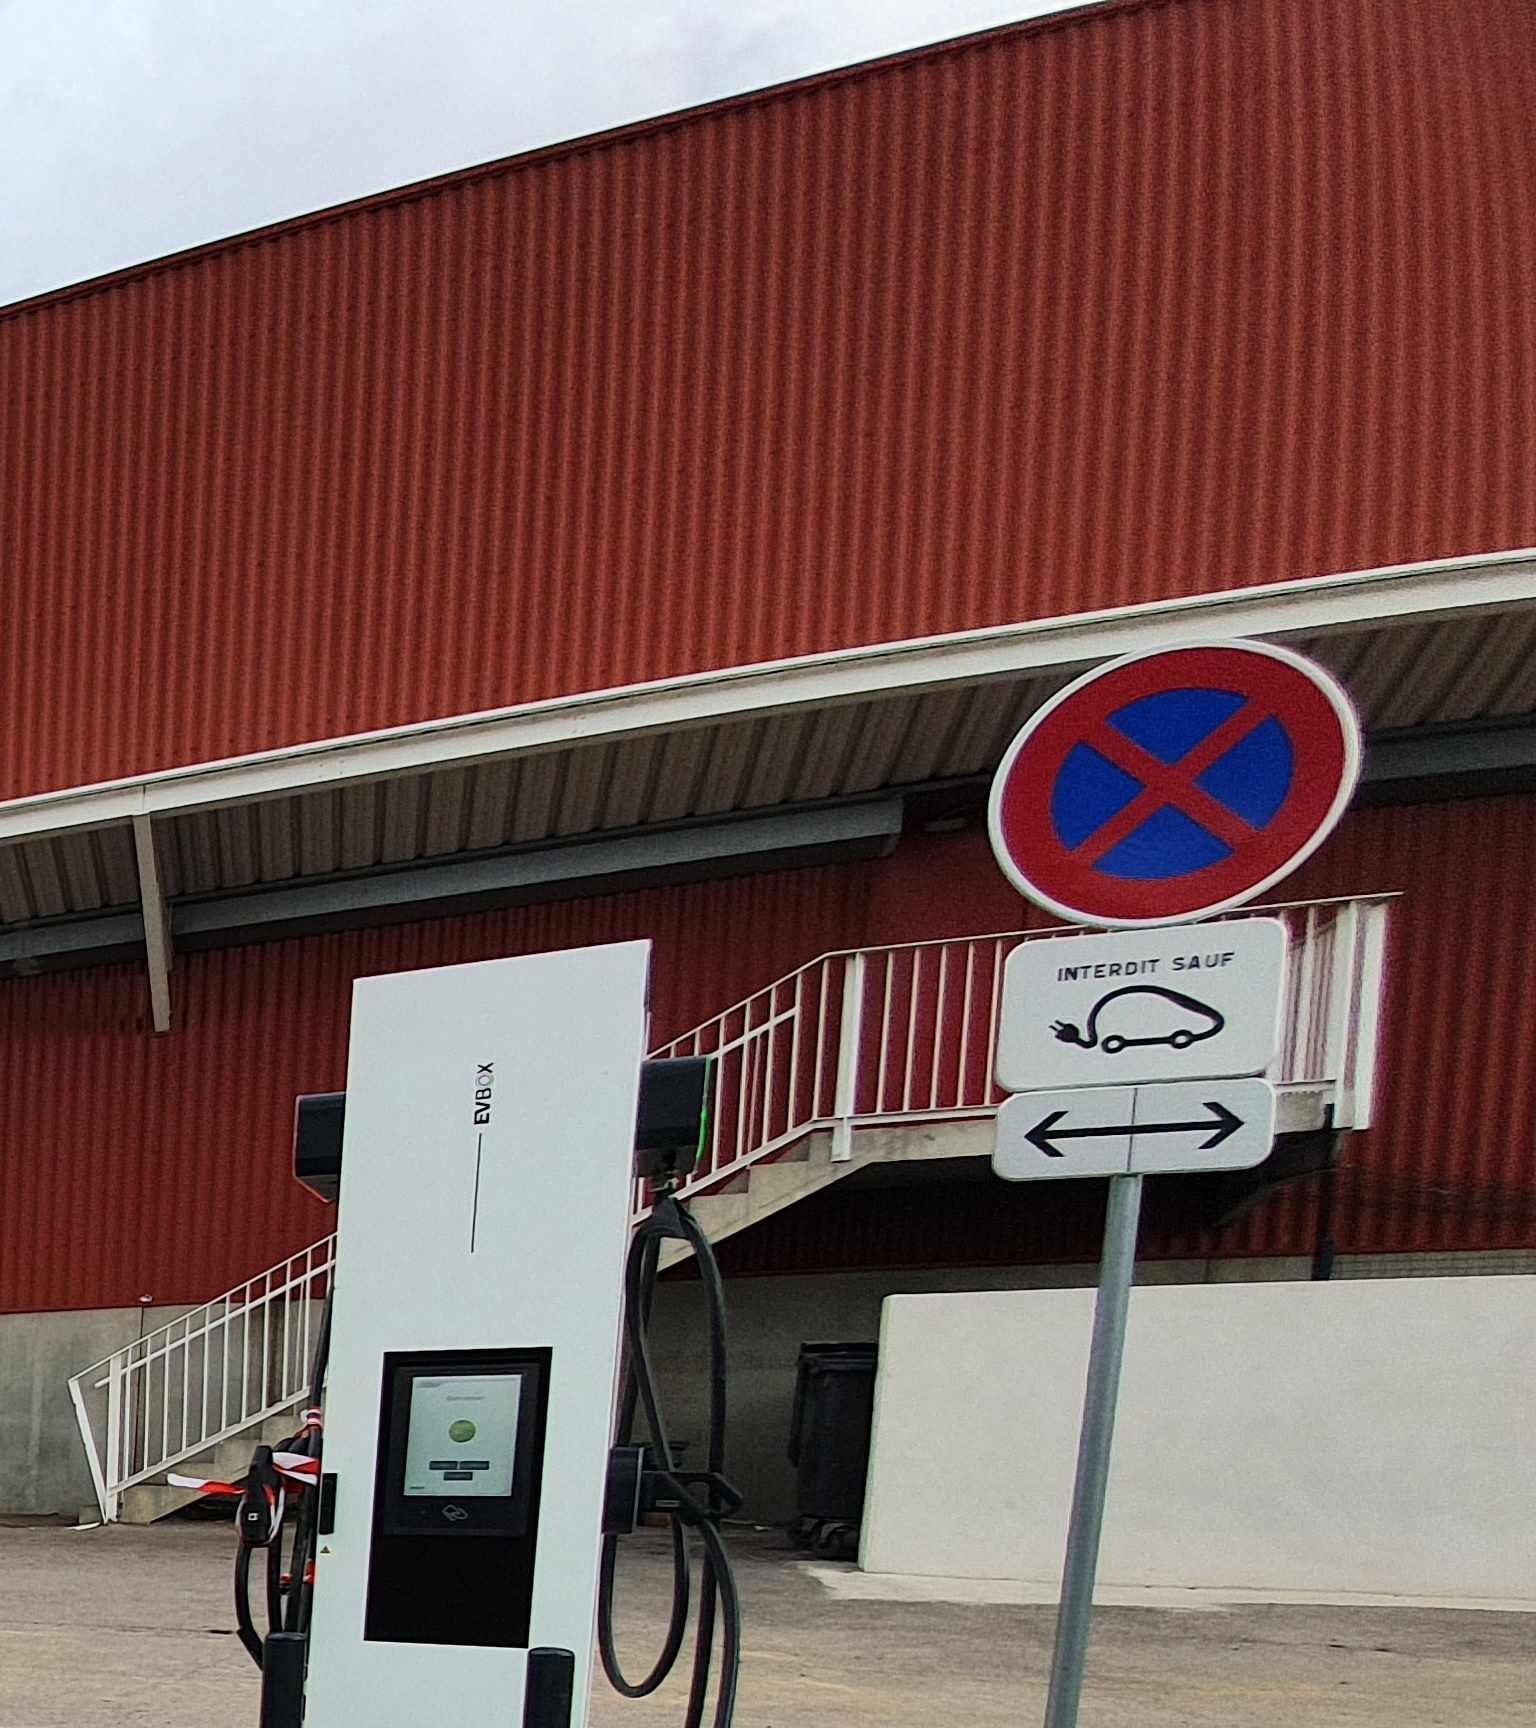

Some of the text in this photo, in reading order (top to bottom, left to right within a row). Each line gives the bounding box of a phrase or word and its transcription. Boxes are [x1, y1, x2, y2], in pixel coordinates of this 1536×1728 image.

[1057, 952, 1235, 982] INTERDIT SAUF
[474, 1062, 494, 1125] EVBOX
